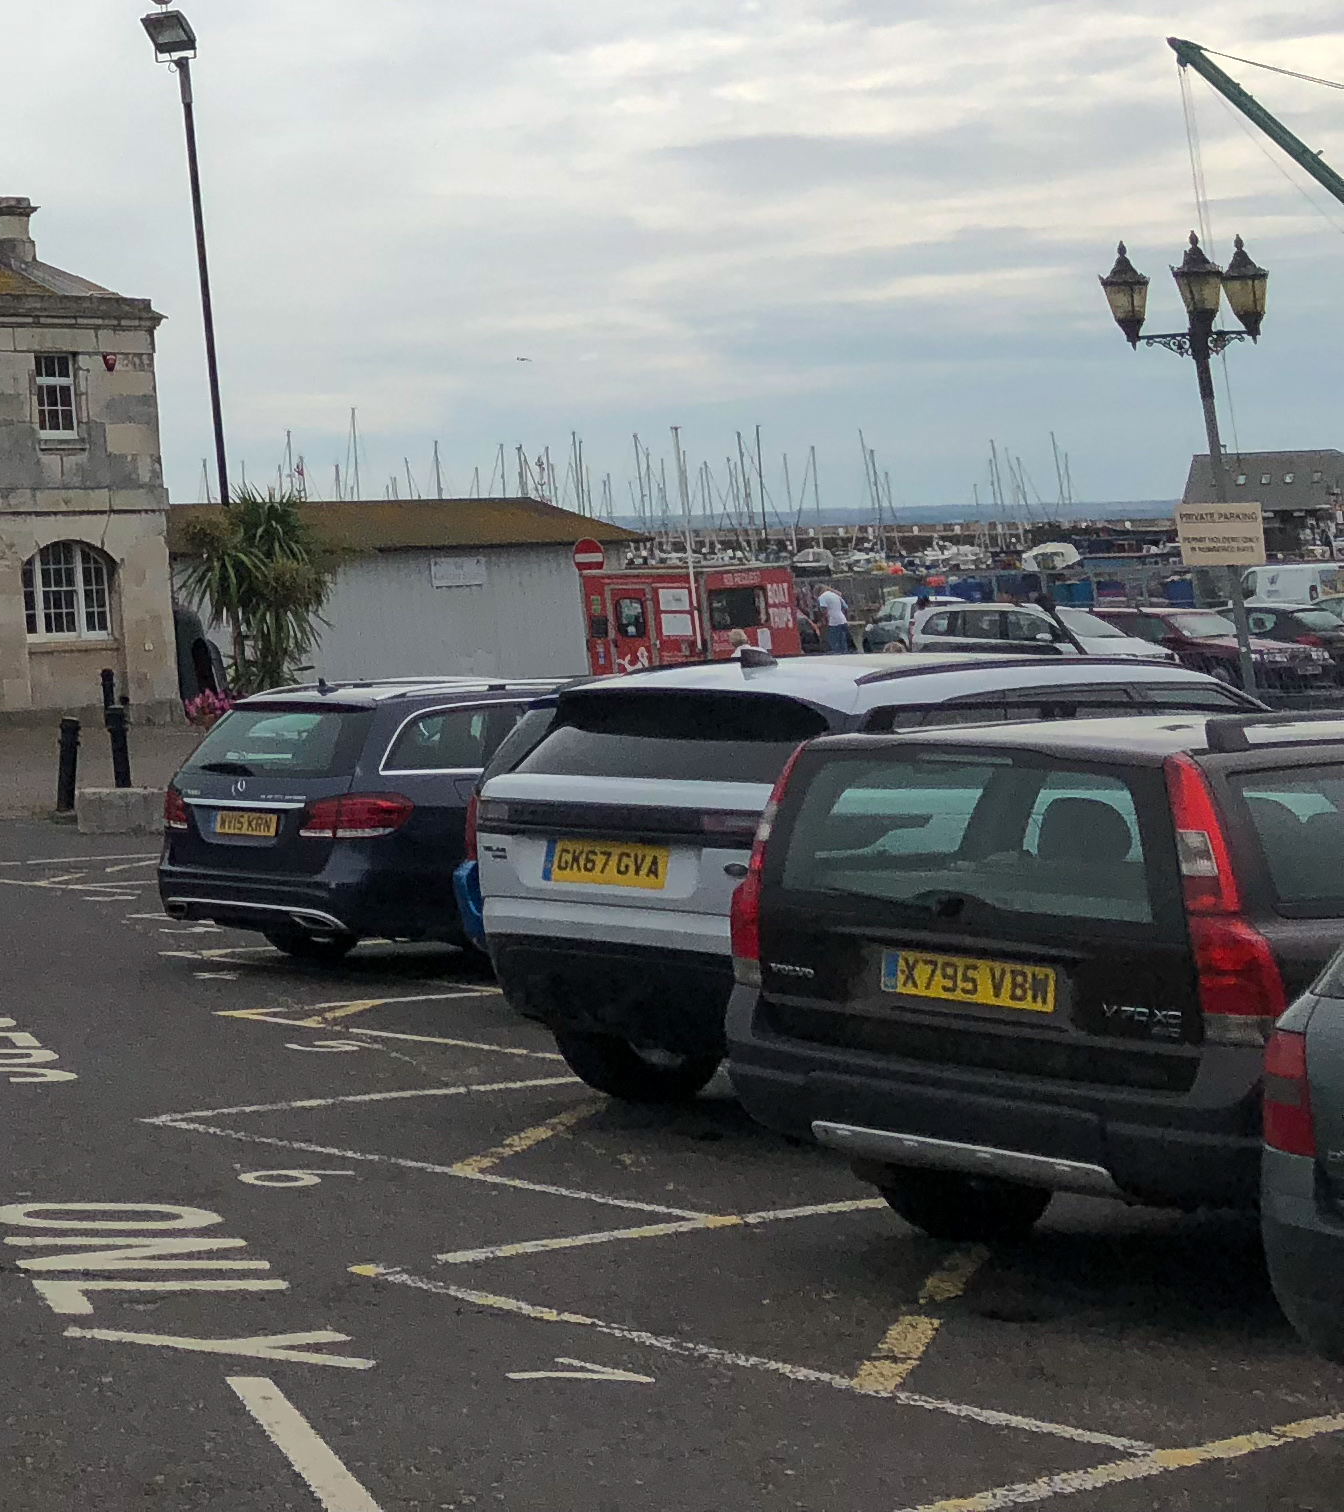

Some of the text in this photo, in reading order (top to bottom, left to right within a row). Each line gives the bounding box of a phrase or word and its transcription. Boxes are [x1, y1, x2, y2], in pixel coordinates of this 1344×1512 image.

[1179, 511, 1258, 522] PRIVATE PARKING
[767, 582, 789, 604] BOAT
[556, 848, 660, 880] GK67 GVA
[899, 957, 1050, 1006] X795 VBW
